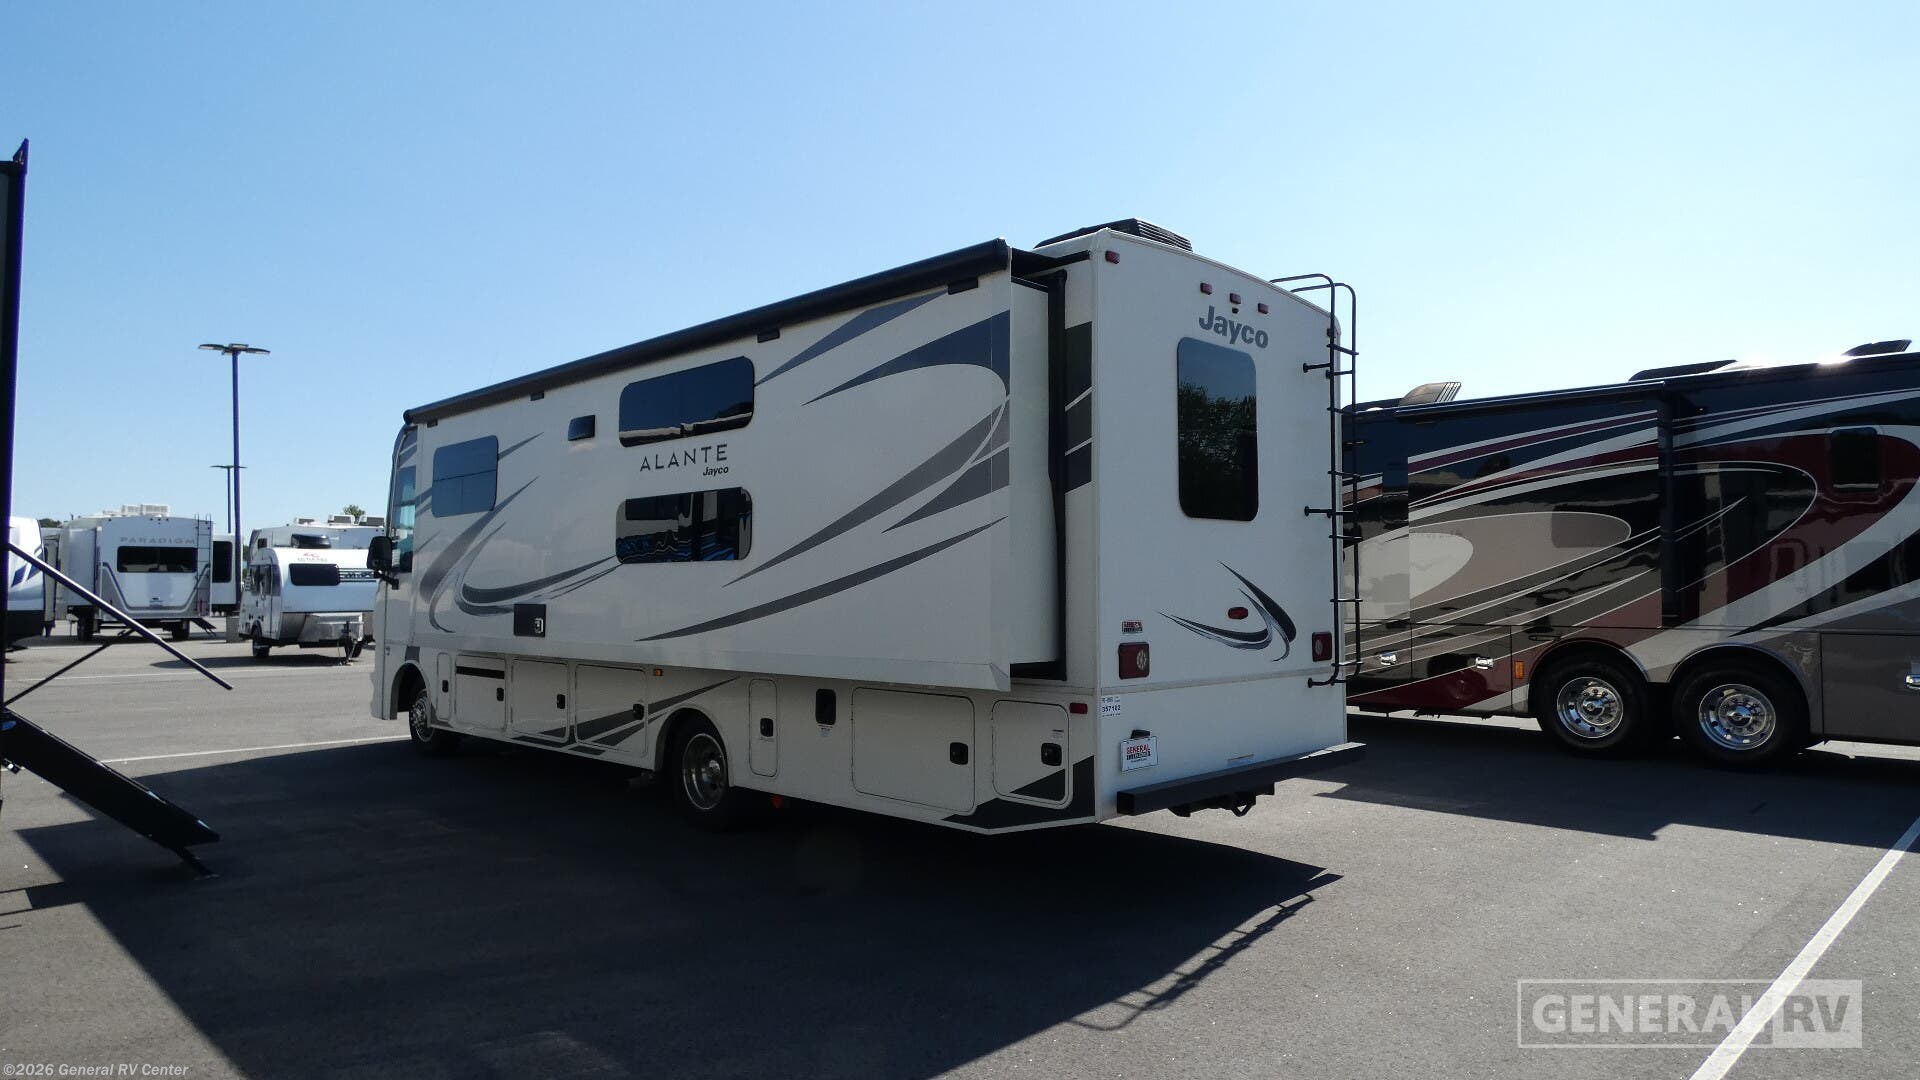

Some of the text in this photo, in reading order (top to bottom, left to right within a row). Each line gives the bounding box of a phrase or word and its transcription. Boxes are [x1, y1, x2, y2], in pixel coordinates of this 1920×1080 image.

[1198, 305, 1269, 349] Jayco
[640, 443, 728, 472] ALANTE
[702, 466, 729, 477] Jayco
